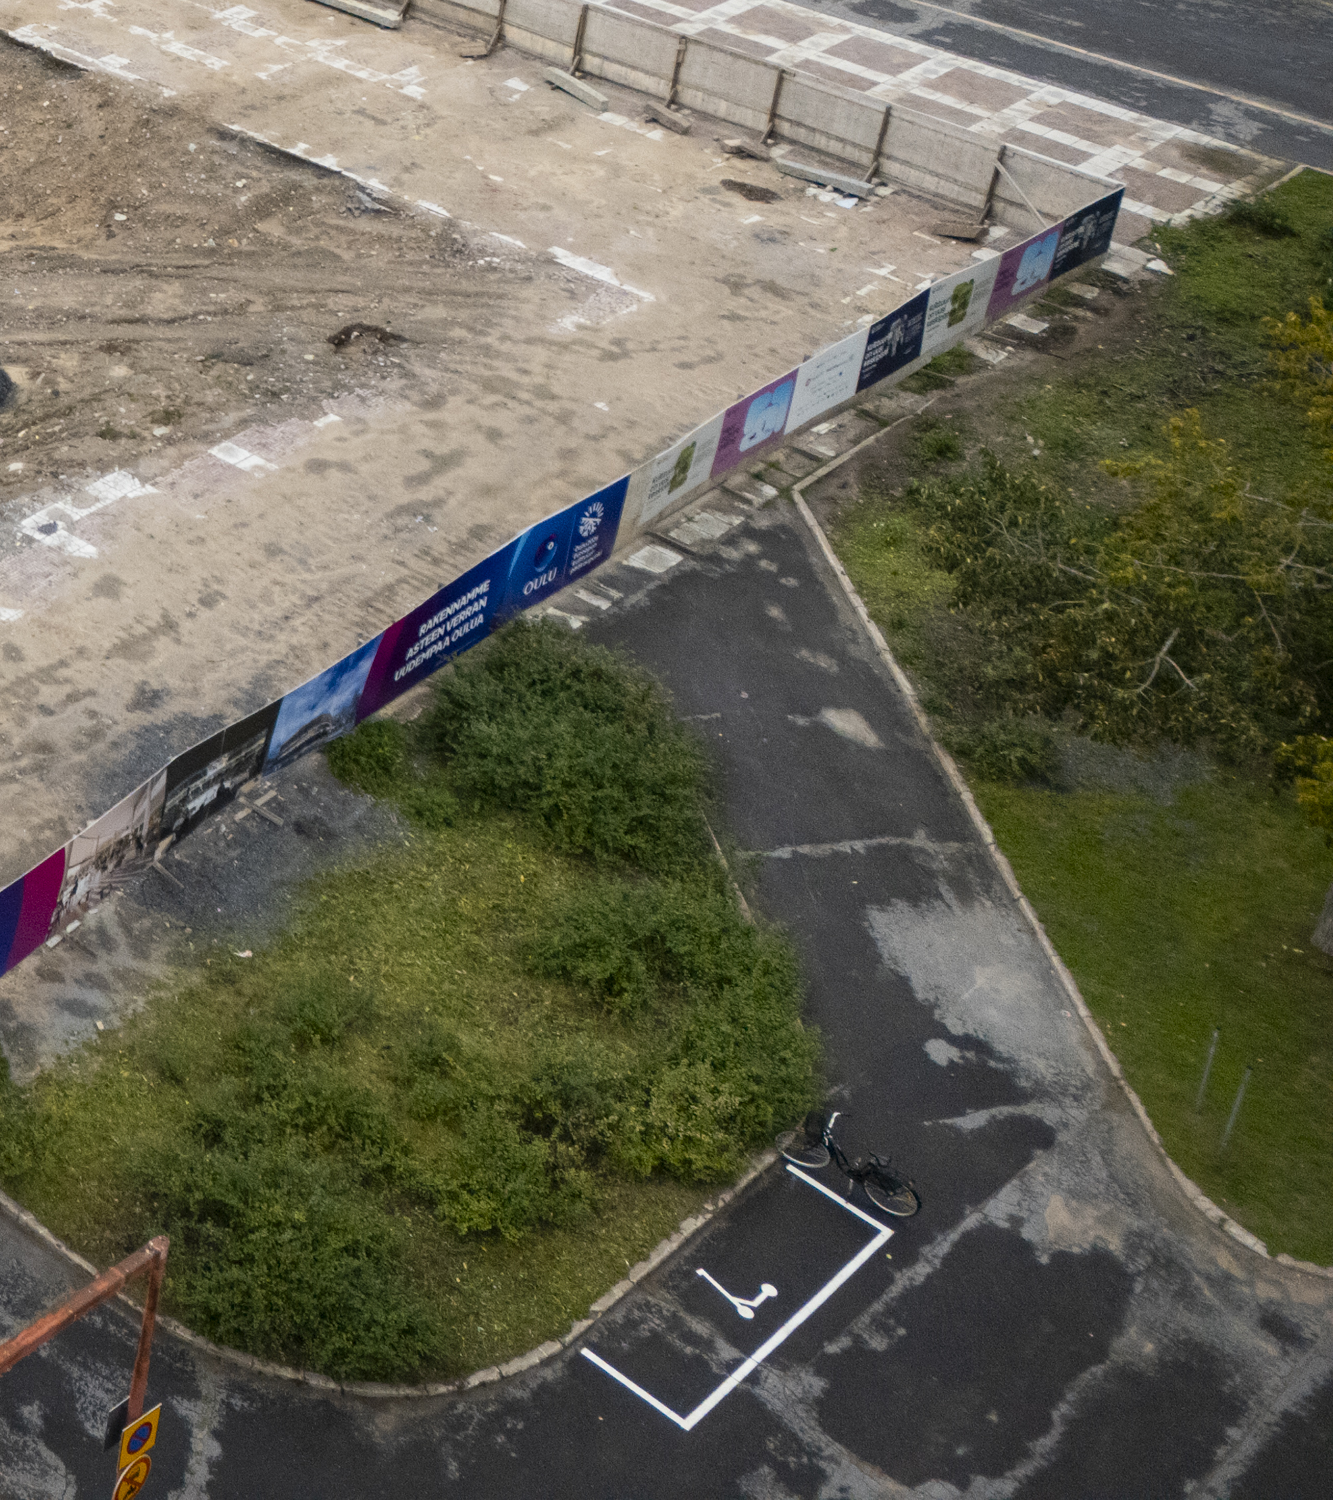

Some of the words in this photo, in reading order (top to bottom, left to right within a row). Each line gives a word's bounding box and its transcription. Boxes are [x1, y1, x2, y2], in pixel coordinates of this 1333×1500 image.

[418, 579, 491, 637] RAKENNAMME
[523, 567, 558, 595] OULU
[393, 635, 450, 682] UUDEMPAA
[450, 613, 485, 643] OULUA
[405, 623, 446, 661] ASTEEN
[446, 596, 488, 632] VERRAN
